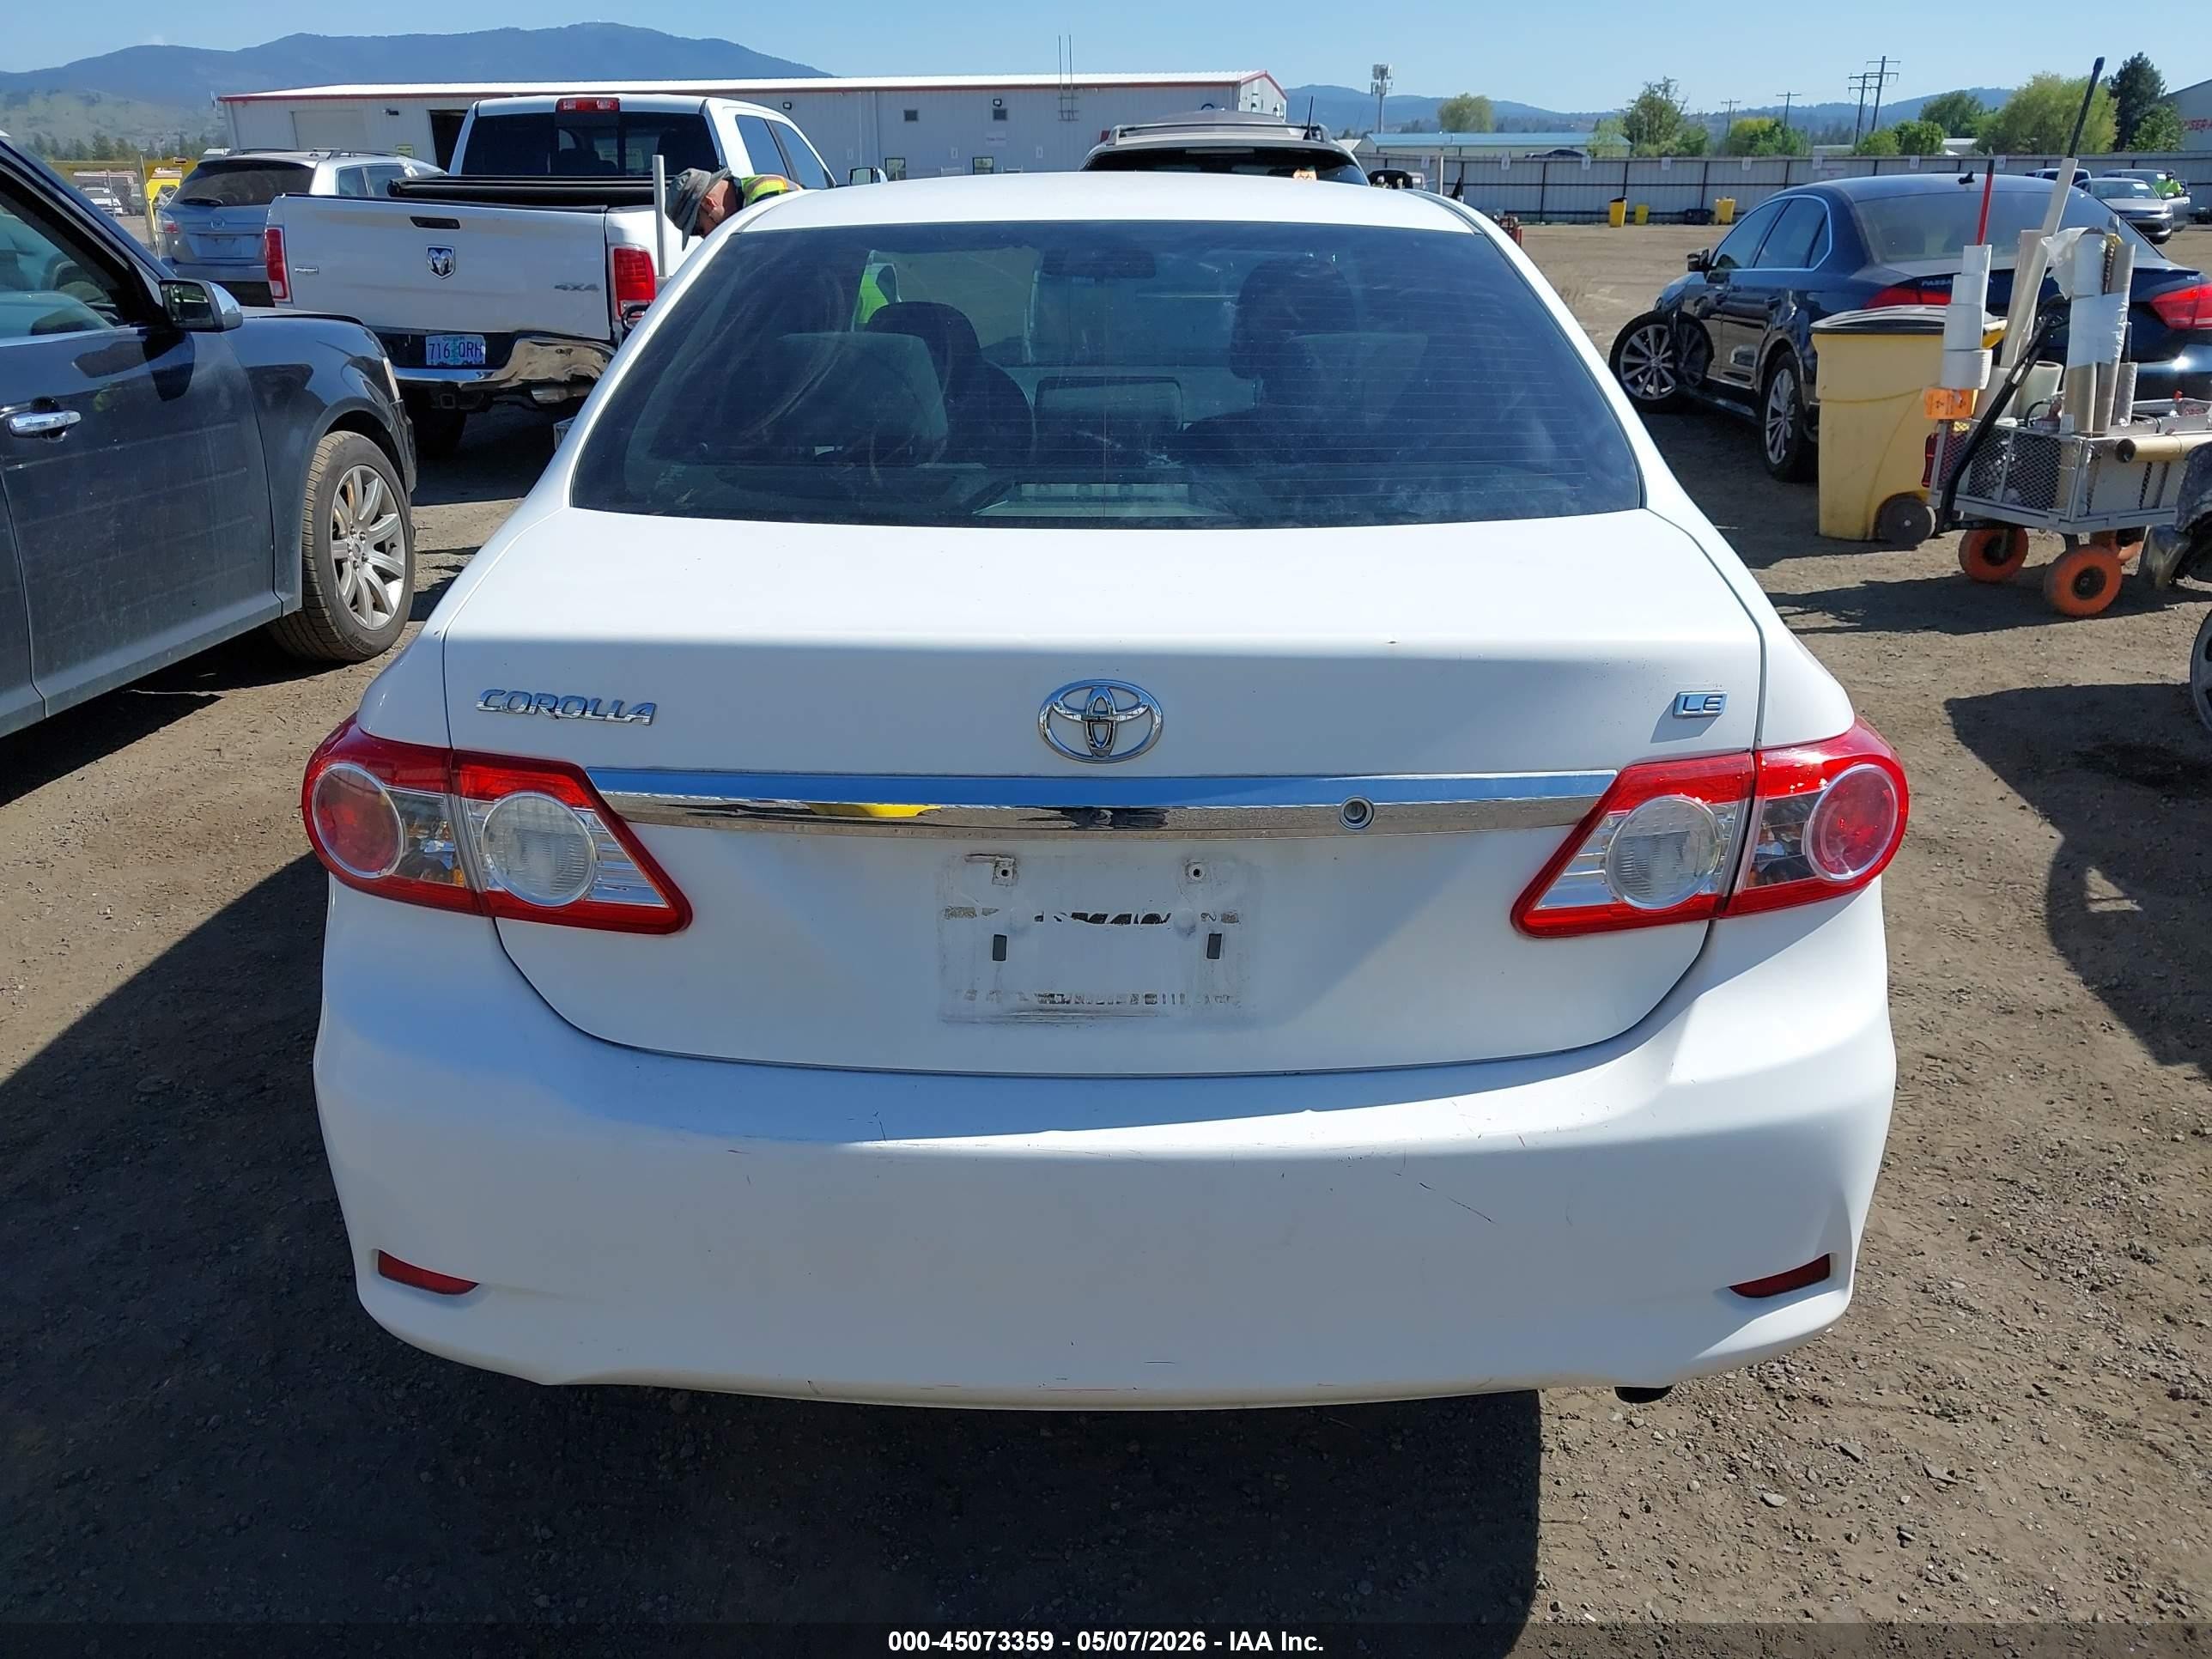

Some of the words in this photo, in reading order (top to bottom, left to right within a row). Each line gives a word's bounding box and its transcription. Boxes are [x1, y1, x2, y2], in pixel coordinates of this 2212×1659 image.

[428, 343, 451, 360] 716
[476, 689, 657, 726] COROLLA
[1680, 693, 1724, 714] LE
